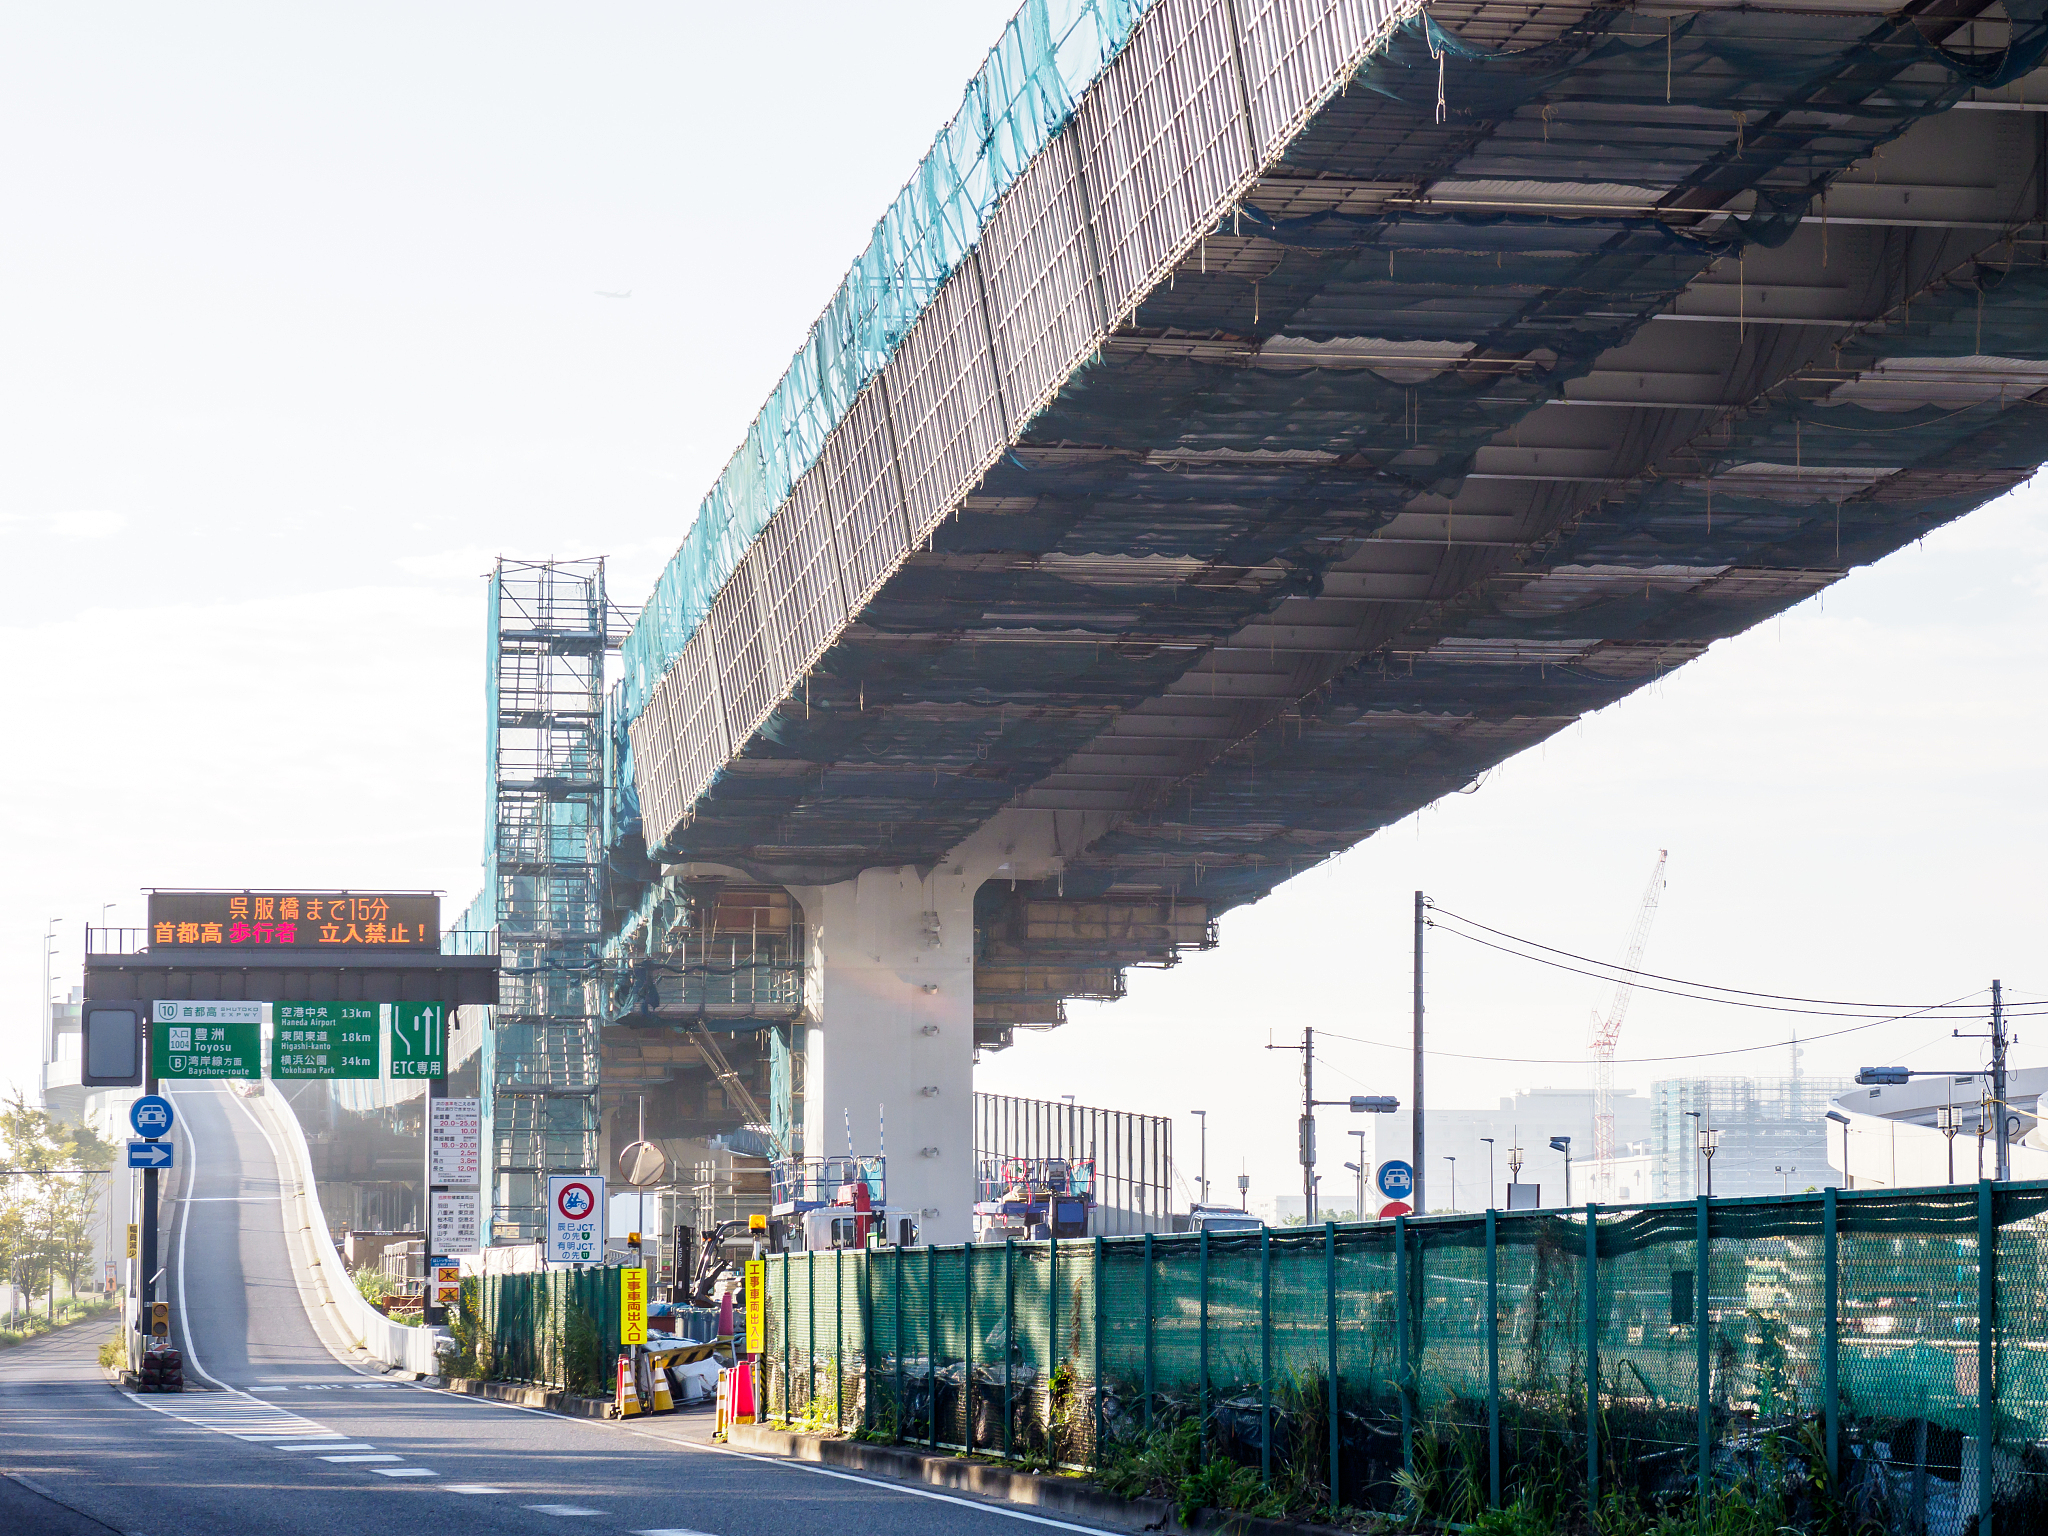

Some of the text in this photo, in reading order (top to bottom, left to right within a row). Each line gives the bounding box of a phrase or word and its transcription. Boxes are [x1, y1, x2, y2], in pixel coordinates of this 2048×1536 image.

[229, 897, 390, 921] 呉服橋まで15分
[153, 921, 223, 944] 首都高
[228, 921, 298, 944] 歩行者
[161, 1005, 175, 1016] 10
[182, 1006, 218, 1017] 首都高
[281, 1006, 371, 1018] 空港中央 13km
[281, 1018, 336, 1027] Haneda Airport
[171, 1029, 189, 1039] 入口
[194, 1027, 225, 1041] 豊洲
[281, 1030, 371, 1042] 東関東道 18km
[170, 1040, 190, 1049] 1004
[194, 1042, 232, 1053] Toyosu
[281, 1042, 331, 1052] Higashi-kanto
[174, 1058, 182, 1068] B
[188, 1055, 242, 1067] 湾岸線方面
[280, 1054, 371, 1066] 横浜公園 34km
[188, 1067, 250, 1076] Bayshore-route
[280, 1066, 335, 1074] Yokohama Park
[392, 1061, 442, 1075] ETC専用
[557, 1222, 596, 1232] 辰巳JCT.
[562, 1232, 580, 1241] の先
[557, 1241, 596, 1251] 有明JCT.
[561, 1251, 580, 1260] の先
[627, 1271, 641, 1342] 工事車両出入口
[749, 1263, 760, 1350] 工事車両出入口
